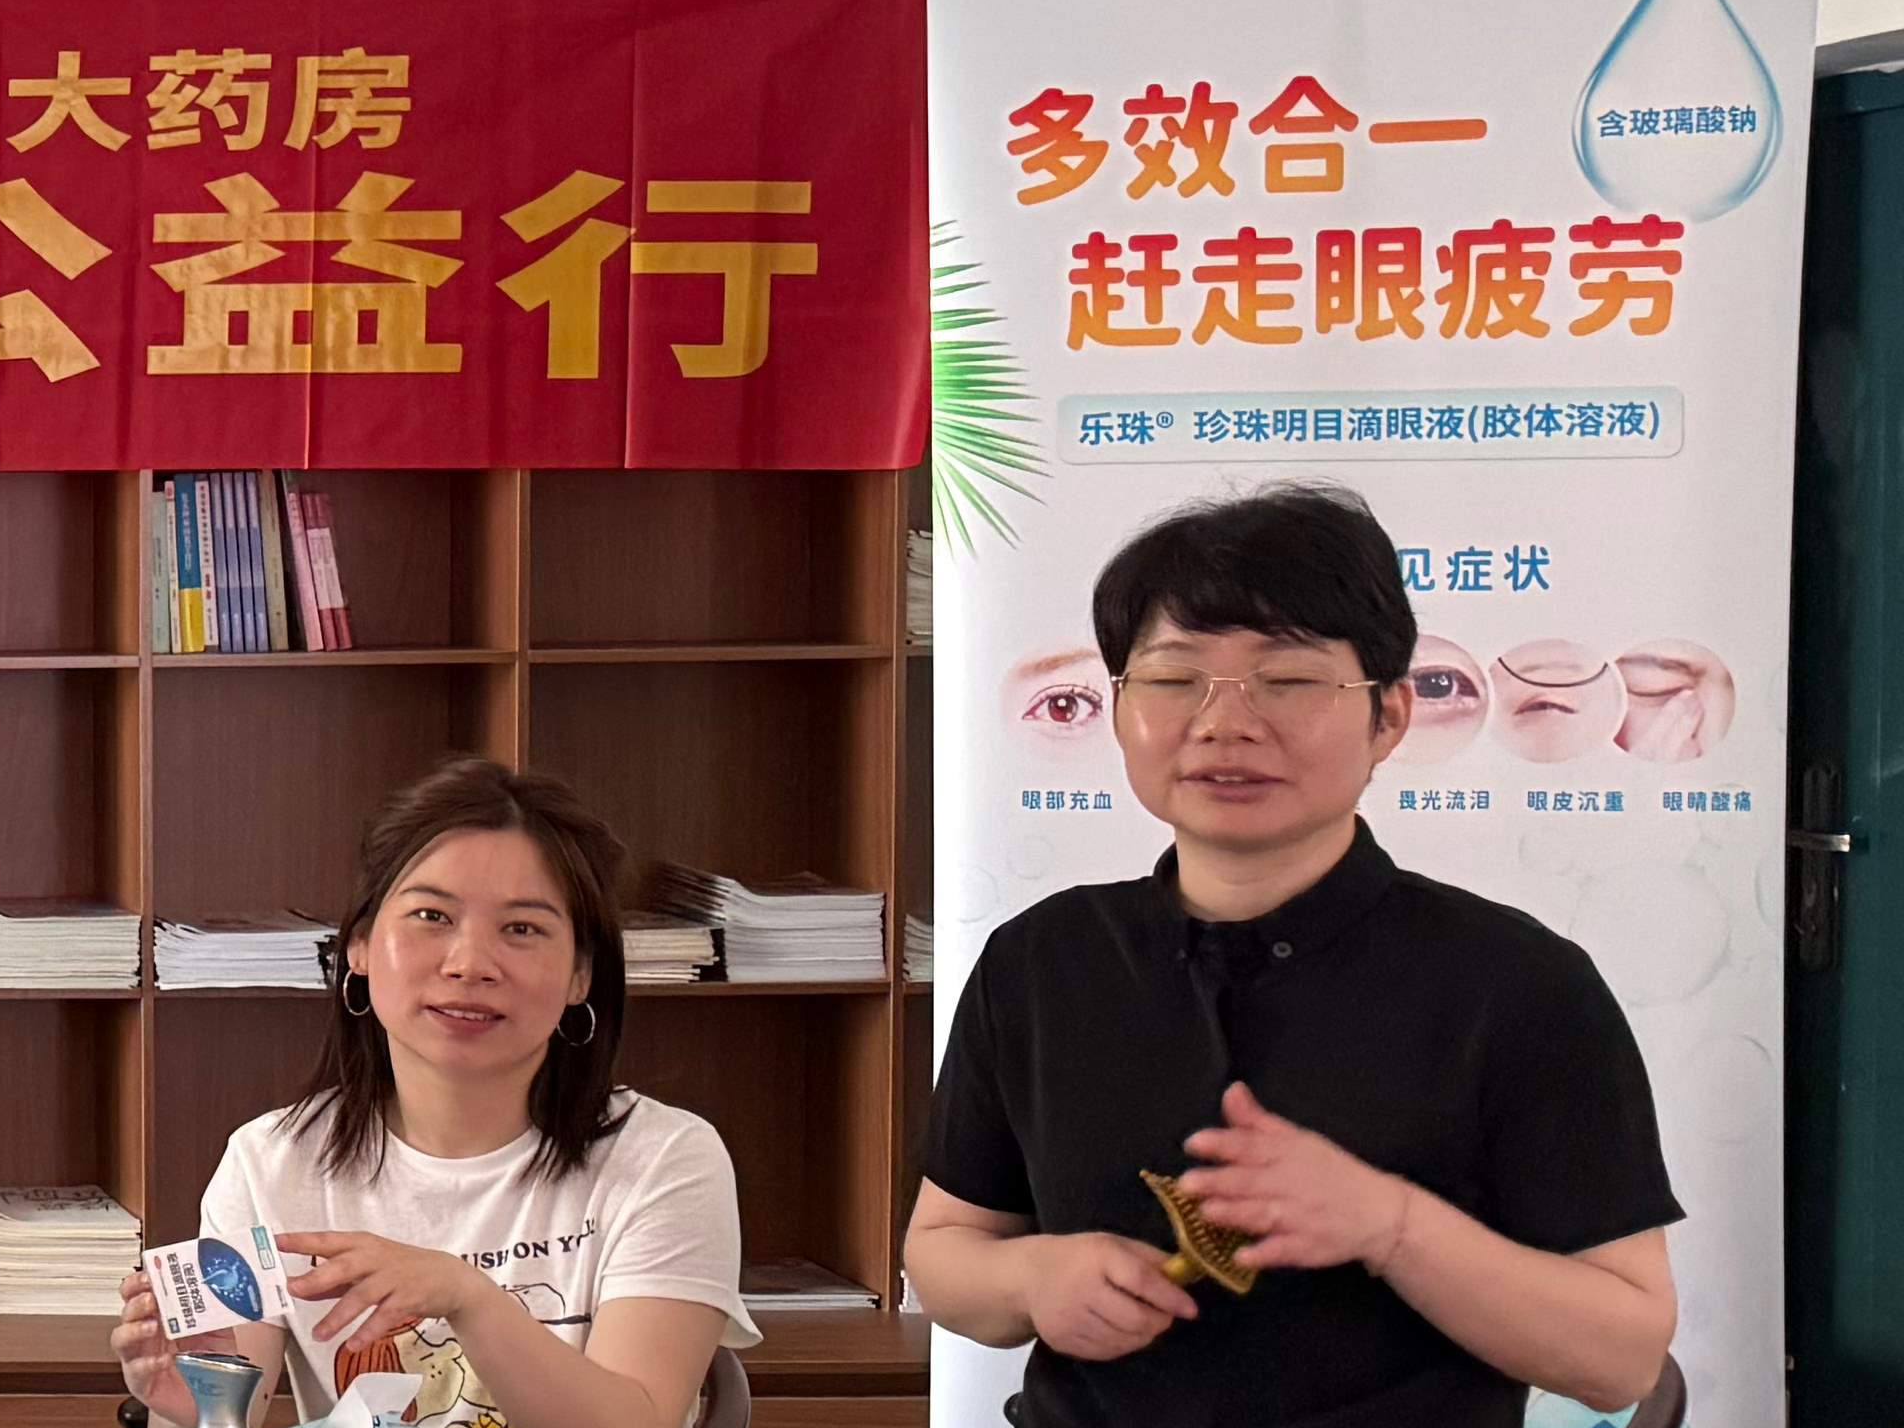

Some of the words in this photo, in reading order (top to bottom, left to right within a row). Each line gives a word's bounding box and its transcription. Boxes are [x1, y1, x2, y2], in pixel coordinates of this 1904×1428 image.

[1006, 75, 1489, 206] 多效合一
[1596, 105, 1759, 140] 含玻璃酸钠
[1066, 213, 1686, 352] 赶走眼疲劳
[1192, 401, 1662, 445] 珍珠明目滴眼液(胶体溶液)
[1021, 789, 1113, 811] 眼部充血
[1398, 789, 1491, 812] 畏光流泪
[1527, 790, 1625, 813] 眼皮沉重
[1662, 790, 1753, 813] 眼睛酸痛
[513, 1239, 550, 1260] ON
